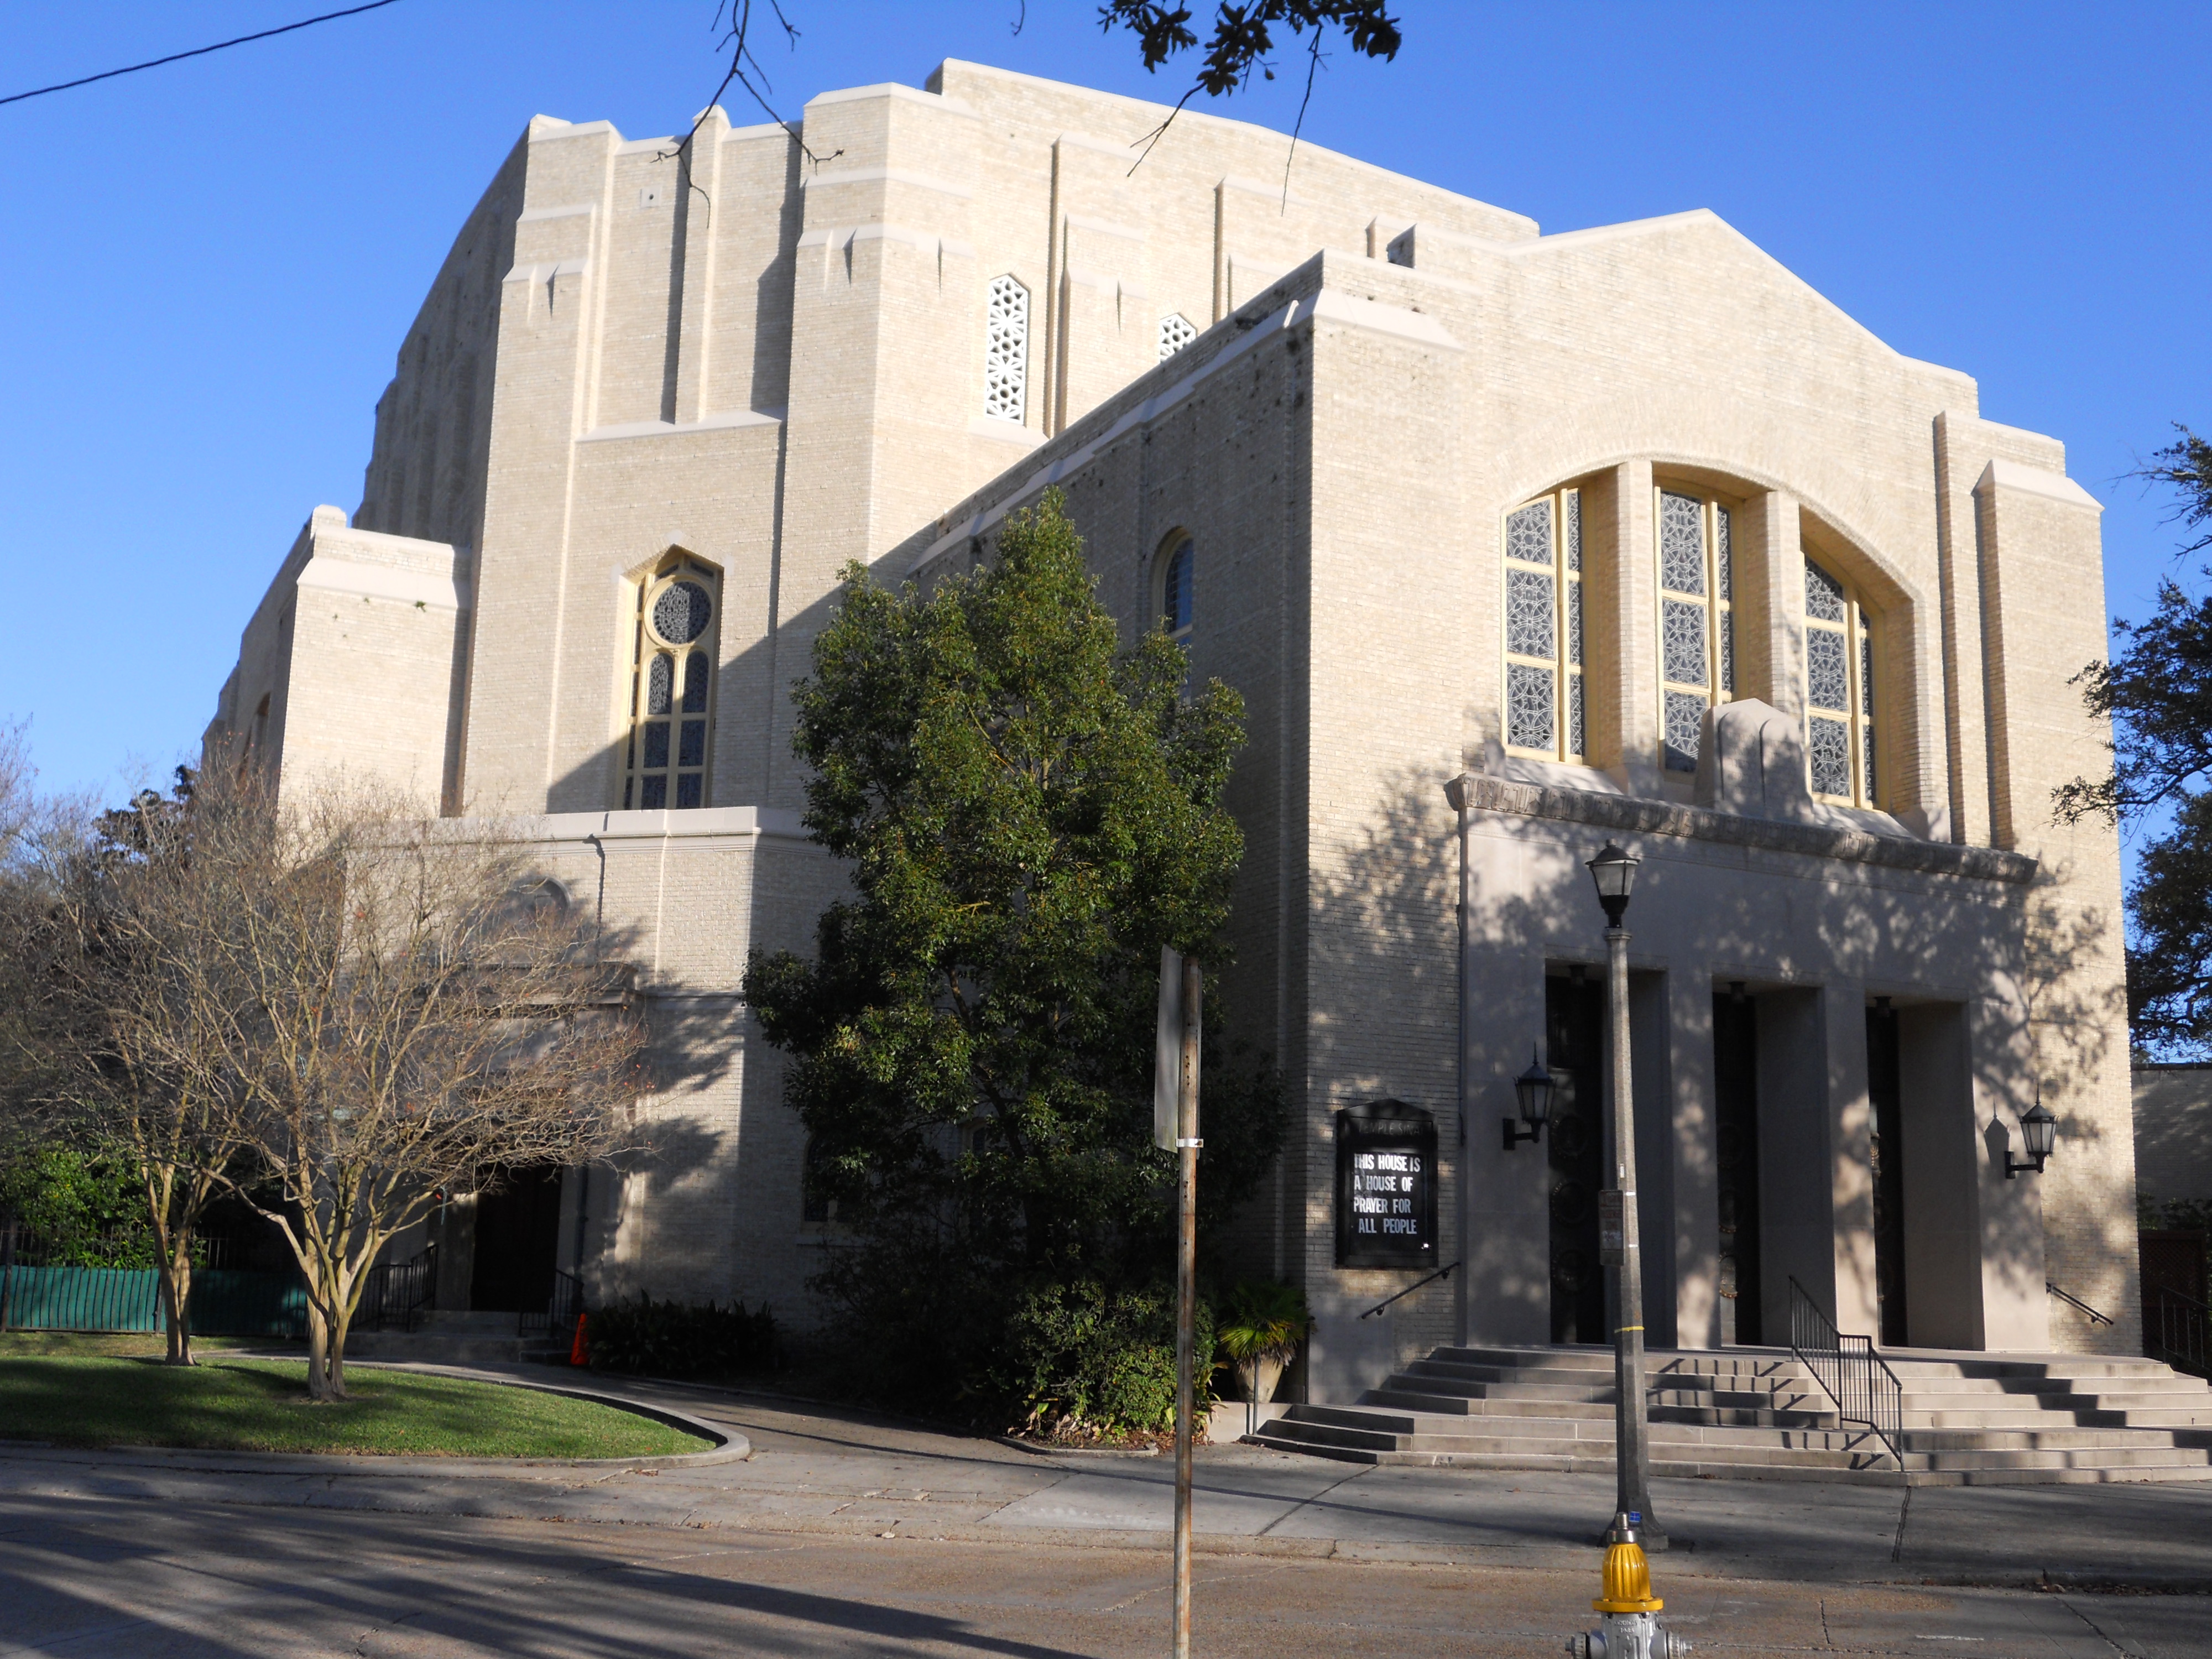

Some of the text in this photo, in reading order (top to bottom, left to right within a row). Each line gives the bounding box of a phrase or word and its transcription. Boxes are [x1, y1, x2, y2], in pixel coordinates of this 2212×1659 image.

[1359, 1120, 1394, 1135] TEMPLE
[1354, 1154, 1421, 1172] THIS HOUSE IS
[1354, 1175, 1413, 1192] A HOUSE OF
[1354, 1197, 1411, 1214] PRAYER FOR
[1359, 1218, 1417, 1234] ALL PEOPLE
